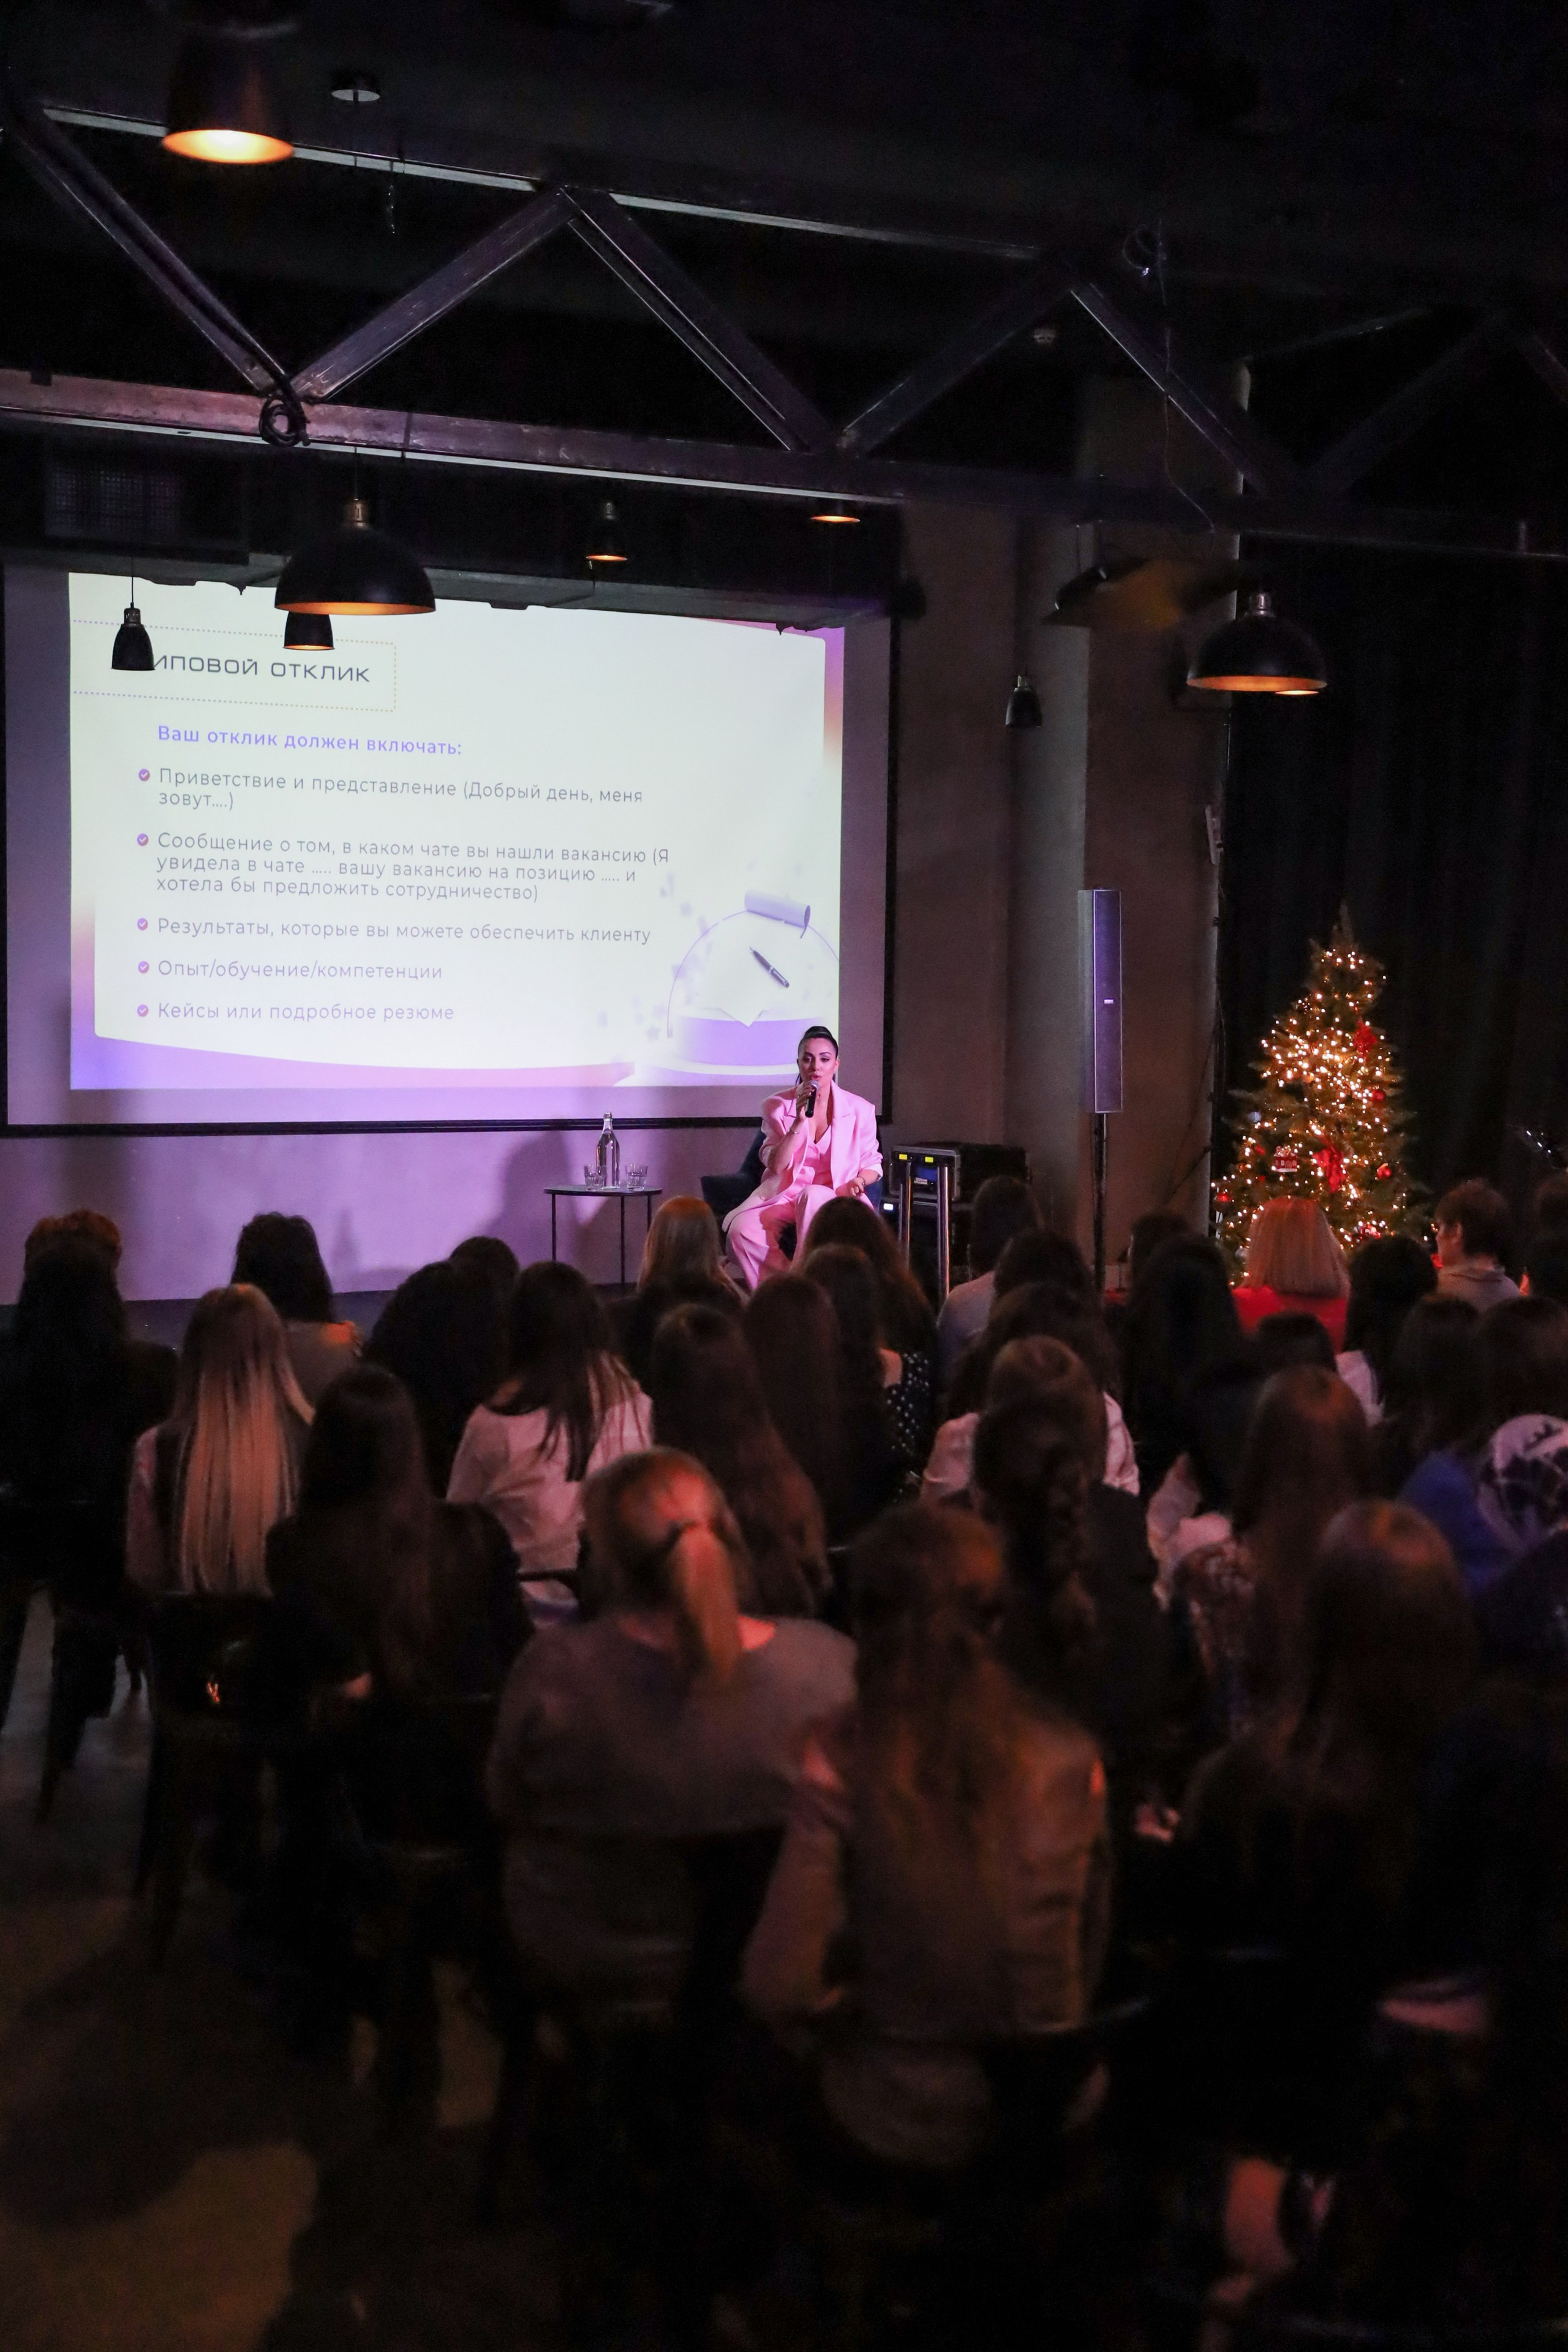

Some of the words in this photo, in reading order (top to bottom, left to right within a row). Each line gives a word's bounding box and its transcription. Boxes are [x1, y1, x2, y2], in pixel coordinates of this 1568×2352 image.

[154, 655, 258, 676] ИПОВОЙ
[270, 662, 371, 683] ОТКЛИК
[158, 725, 199, 742] Ваш
[207, 731, 277, 747] отклик
[284, 735, 359, 750] должен
[367, 739, 461, 755] включать:
[159, 767, 287, 790] Приветствие
[294, 778, 303, 789] и
[312, 778, 457, 796] представление
[463, 780, 540, 801] (Добрый
[546, 788, 593, 804] день,
[599, 790, 643, 803] меня
[157, 831, 273, 852] Сообщение
[280, 840, 290, 851] о
[296, 840, 335, 856] том,
[343, 842, 351, 854] в
[359, 842, 413, 856] каком
[421, 845, 460, 858] чате
[467, 845, 489, 858] вы
[496, 846, 554, 860] нашли
[561, 848, 646, 863] вакансию
[652, 848, 669, 866] (Я
[156, 857, 240, 873] увидела
[248, 860, 257, 872] в
[263, 860, 305, 873] чате
[339, 862, 386, 880] вашу
[393, 864, 482, 878] вакансию
[489, 867, 509, 879] на
[516, 867, 595, 883] позицию
[627, 871, 635, 881] и
[156, 878, 223, 892] хотела
[230, 875, 255, 893] бы
[263, 881, 379, 897] предложить
[385, 884, 538, 903] сотрудничество)
[158, 918, 274, 938] Результаты,
[281, 923, 360, 940] которые
[366, 925, 389, 937] вы
[396, 925, 464, 939] можете
[470, 923, 575, 941] обеспечить
[581, 929, 651, 946] клиенту
[158, 959, 442, 981] Опыт/обучение/компетенции
[158, 1002, 219, 1019] Кейсы
[227, 1007, 262, 1019] или
[270, 1003, 376, 1022] подробное
[383, 1008, 454, 1022] резюме
